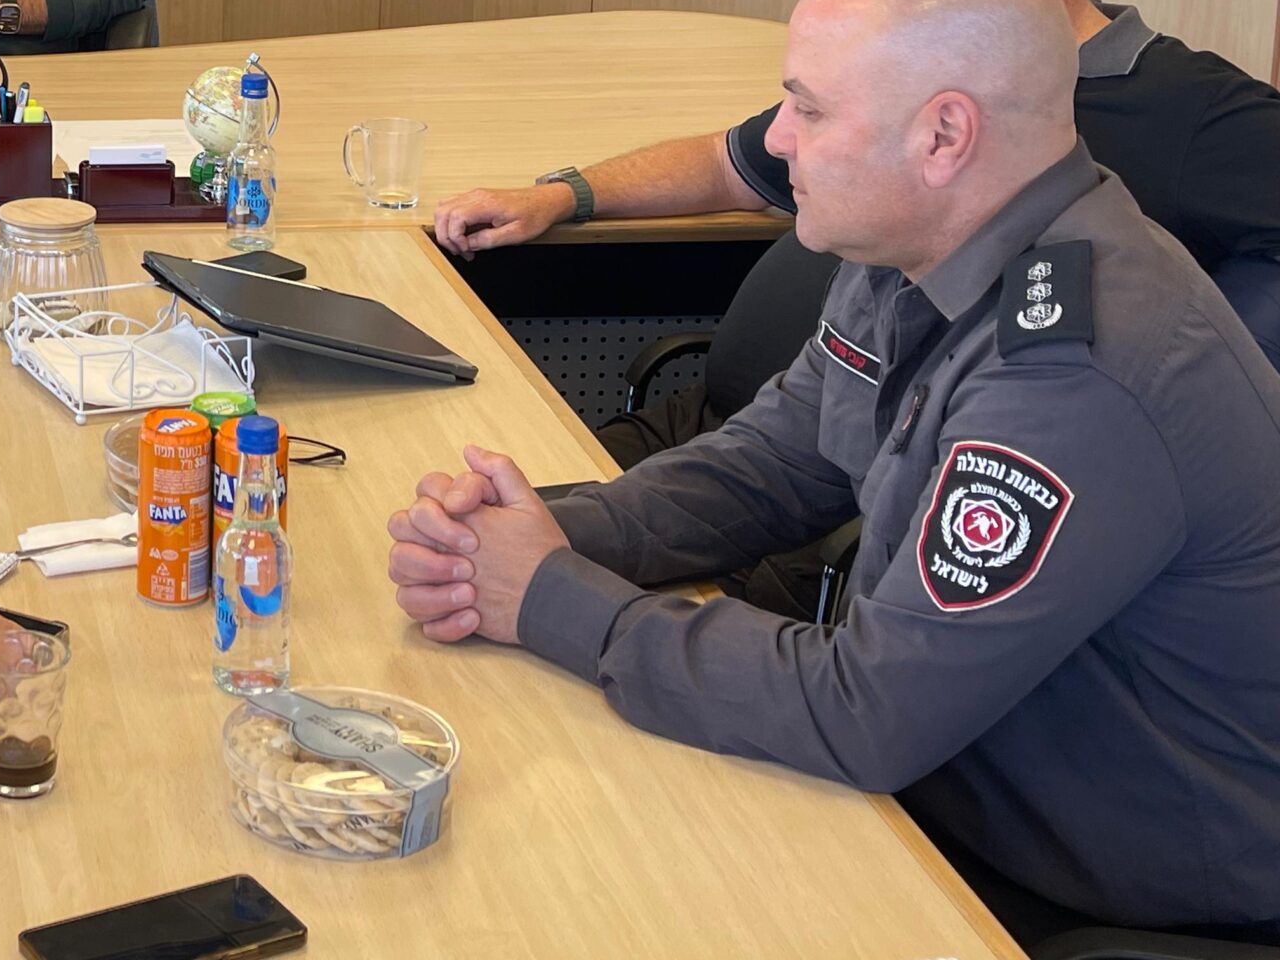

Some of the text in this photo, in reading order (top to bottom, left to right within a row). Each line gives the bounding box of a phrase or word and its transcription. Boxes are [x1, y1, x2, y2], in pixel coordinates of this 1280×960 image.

[213, 463, 286, 503] FAA
[957, 451, 1059, 510] כבאות והצלה
[149, 503, 187, 520] FANTA
[931, 553, 989, 594] לישראל
